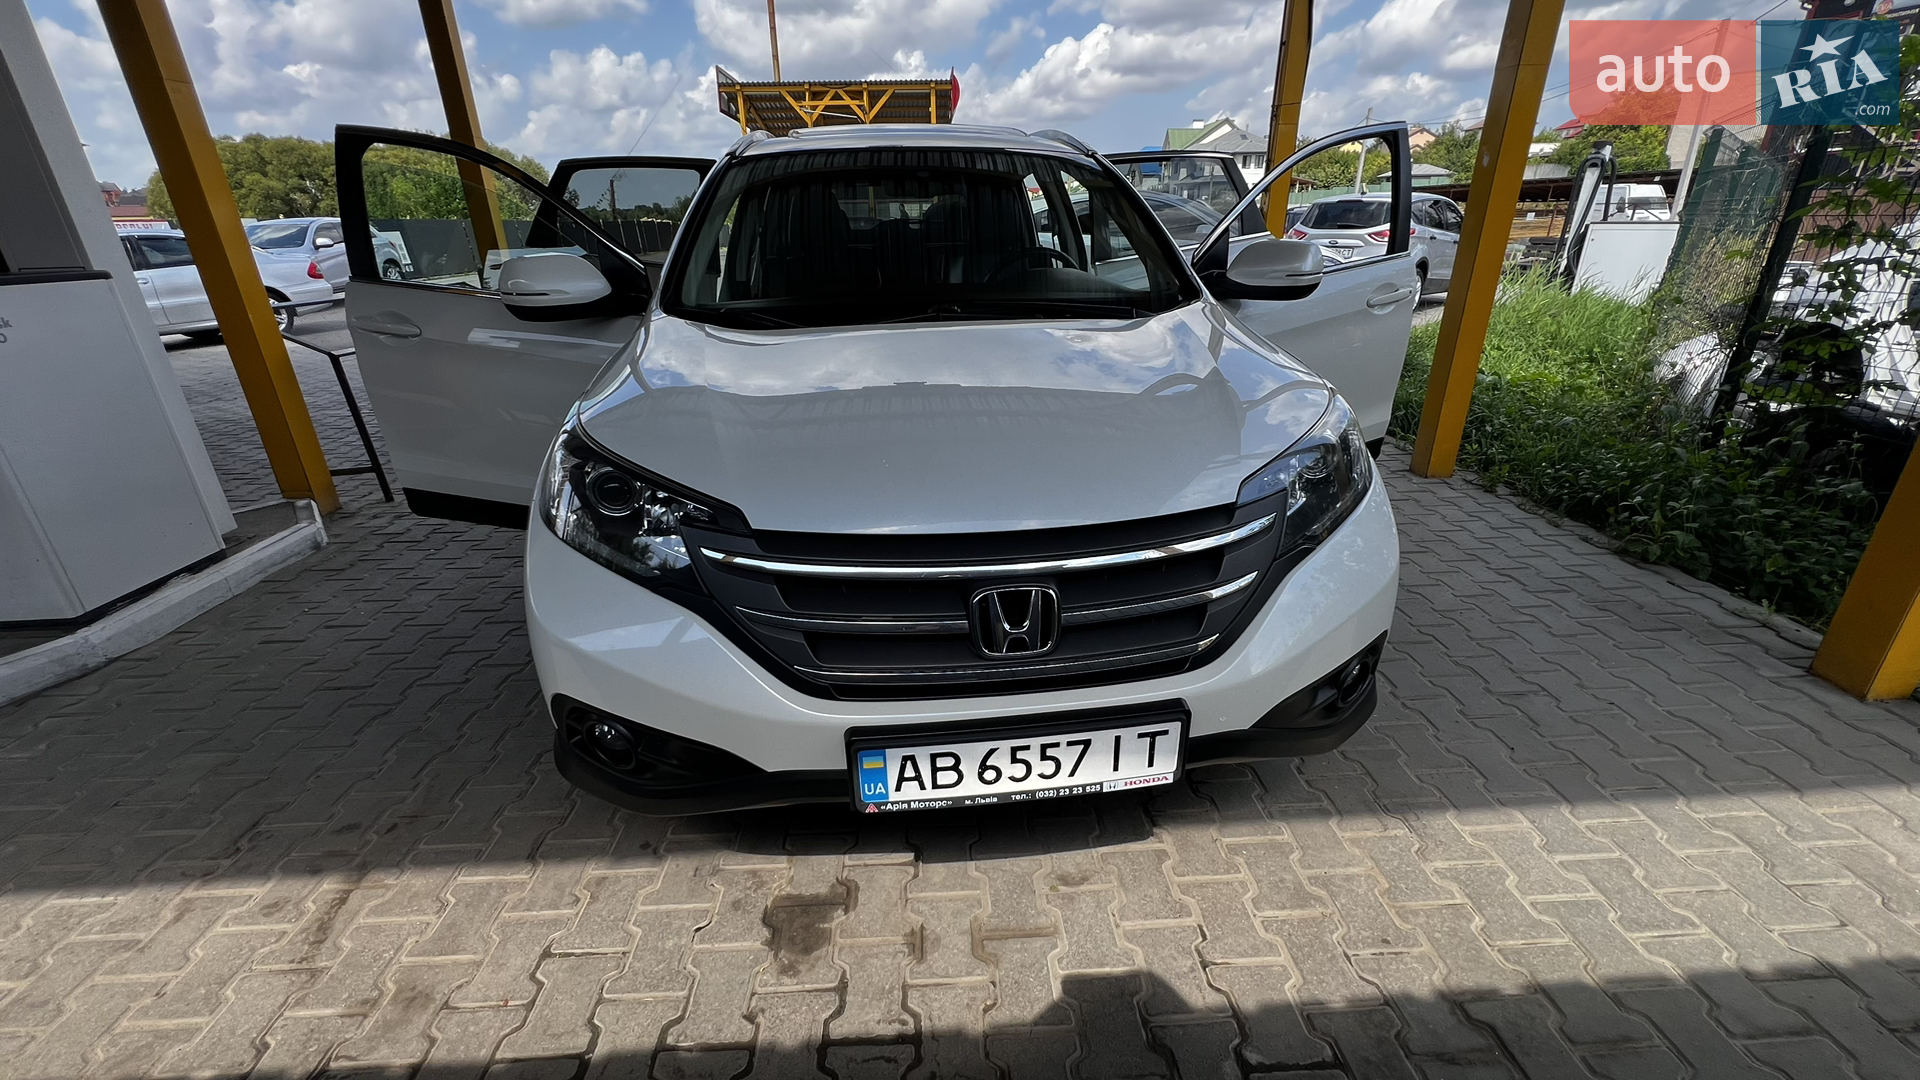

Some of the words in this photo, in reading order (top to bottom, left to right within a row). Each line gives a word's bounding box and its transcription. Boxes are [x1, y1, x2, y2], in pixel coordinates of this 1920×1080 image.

[894, 751, 964, 792] AB
[977, 738, 1093, 785] 6557
[1112, 729, 1170, 772] IT
[1123, 775, 1170, 787] HONDA
[864, 782, 886, 795] UA
[1035, 788, 1057, 799] (032)
[1058, 788, 1070, 796] 23
[1085, 784, 1101, 792] 525
